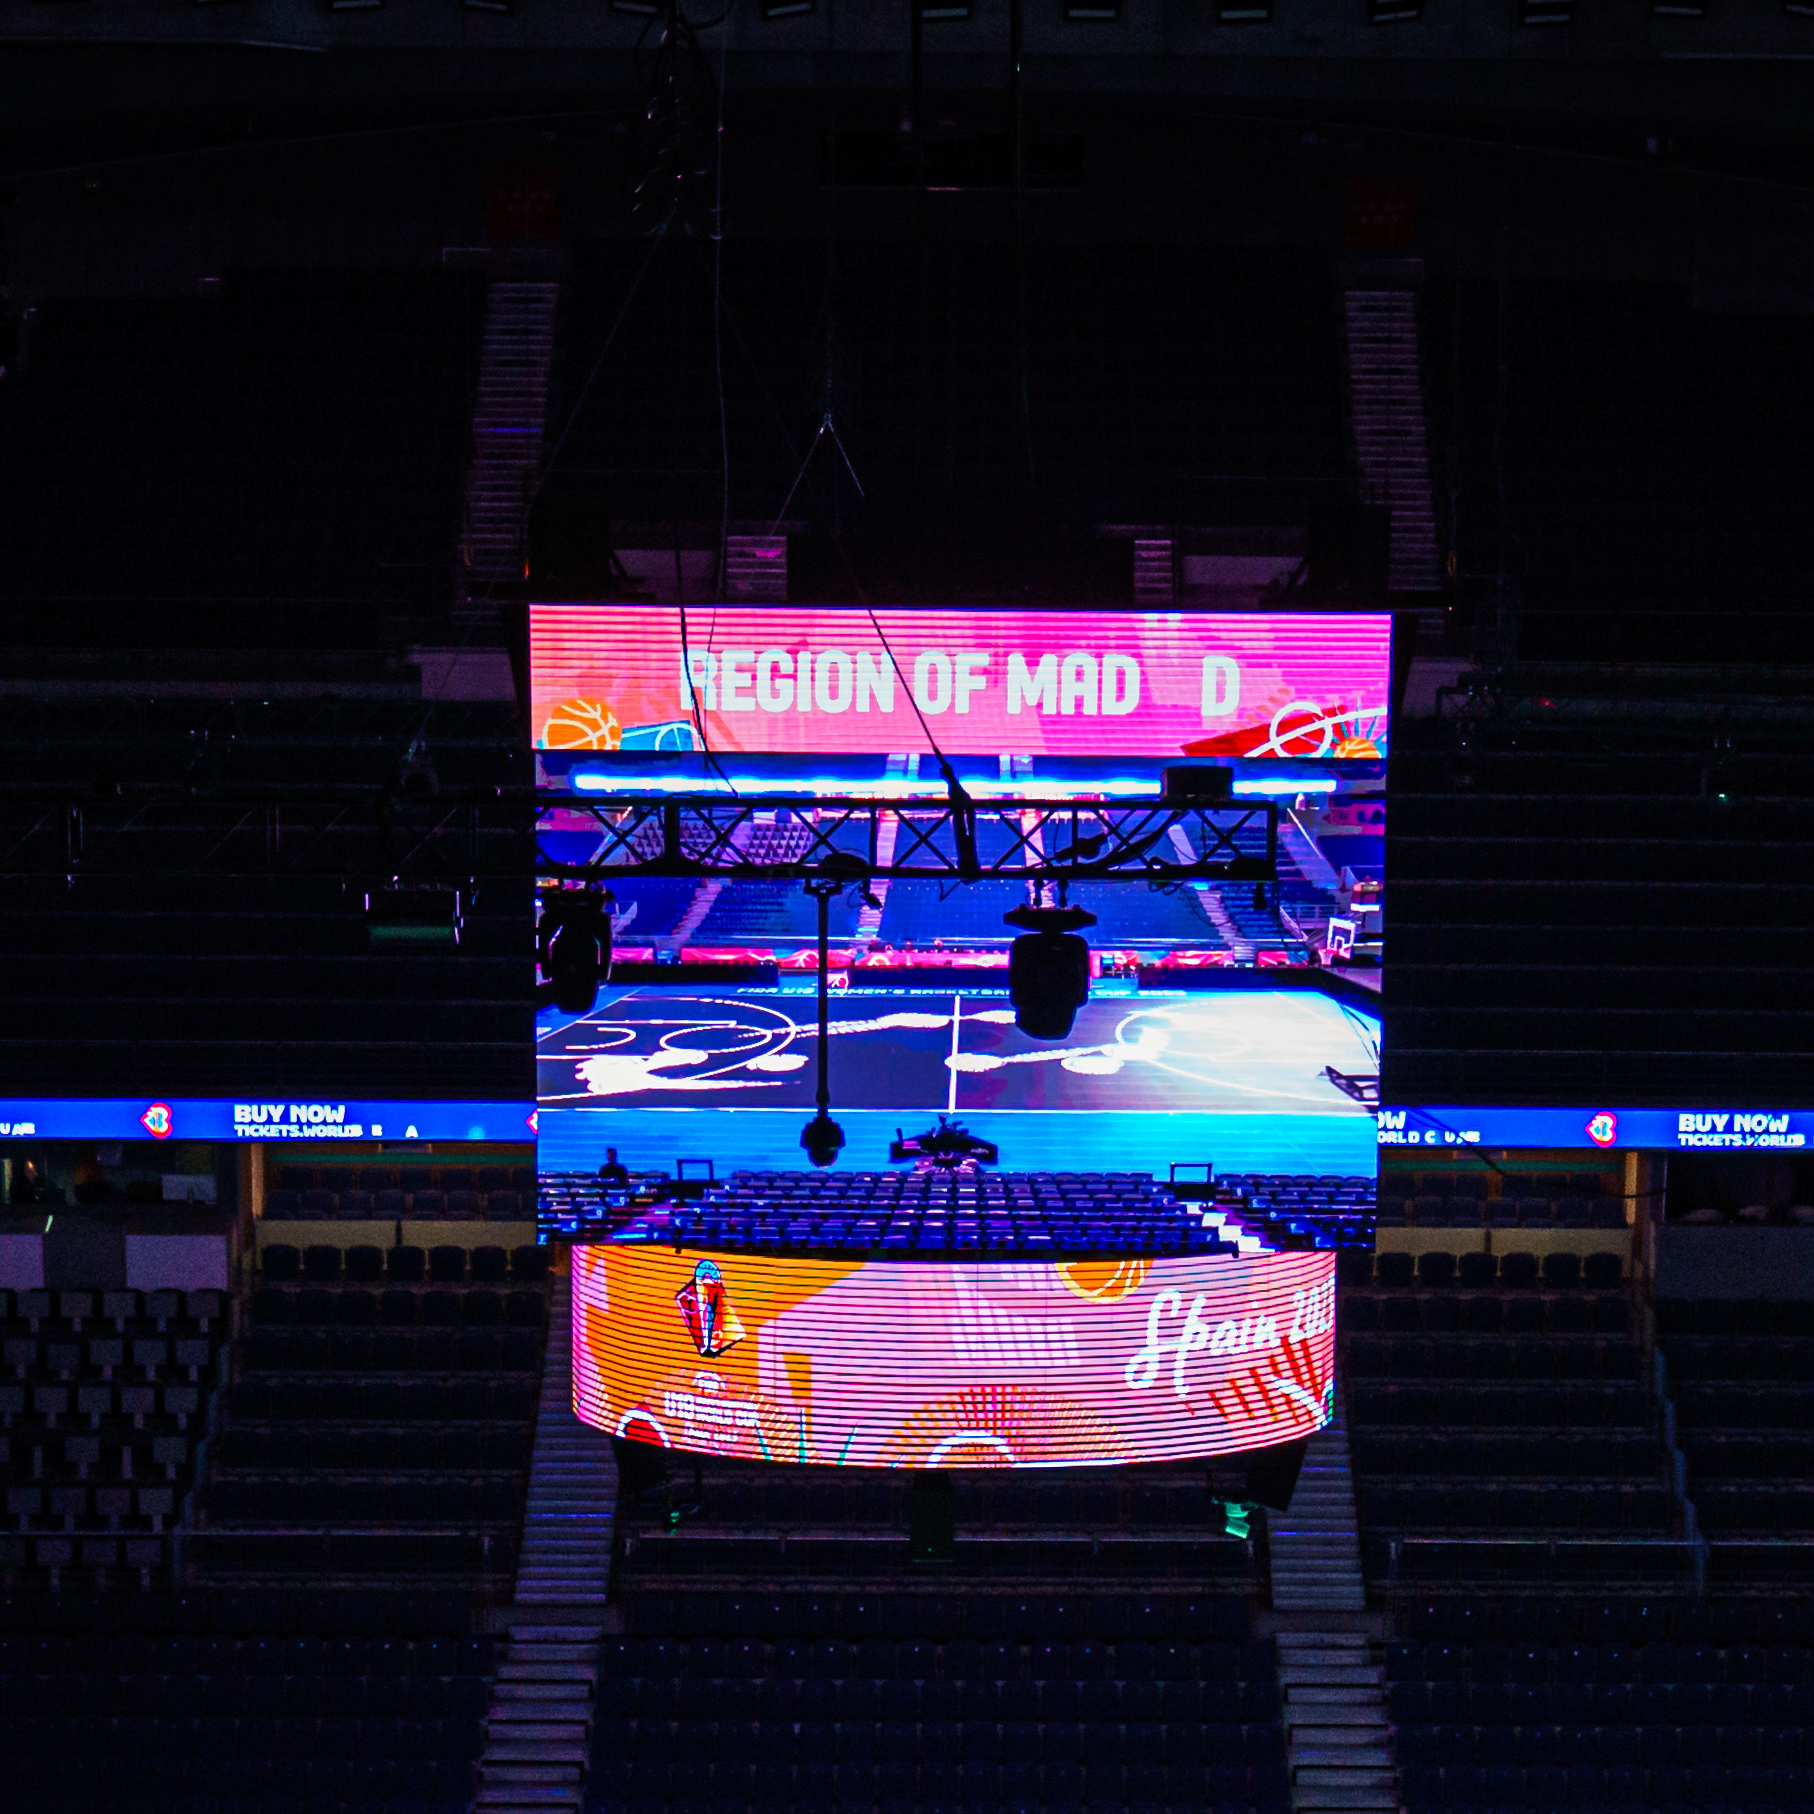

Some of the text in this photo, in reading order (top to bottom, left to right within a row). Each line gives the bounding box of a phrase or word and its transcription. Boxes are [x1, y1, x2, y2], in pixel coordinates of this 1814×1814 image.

[680, 650, 1240, 718] REGION OF MAD D
[234, 1105, 346, 1123] BUY NOW
[1679, 1114, 1789, 1132] BUY NOW
[1124, 1288, 1281, 1398] Spain
